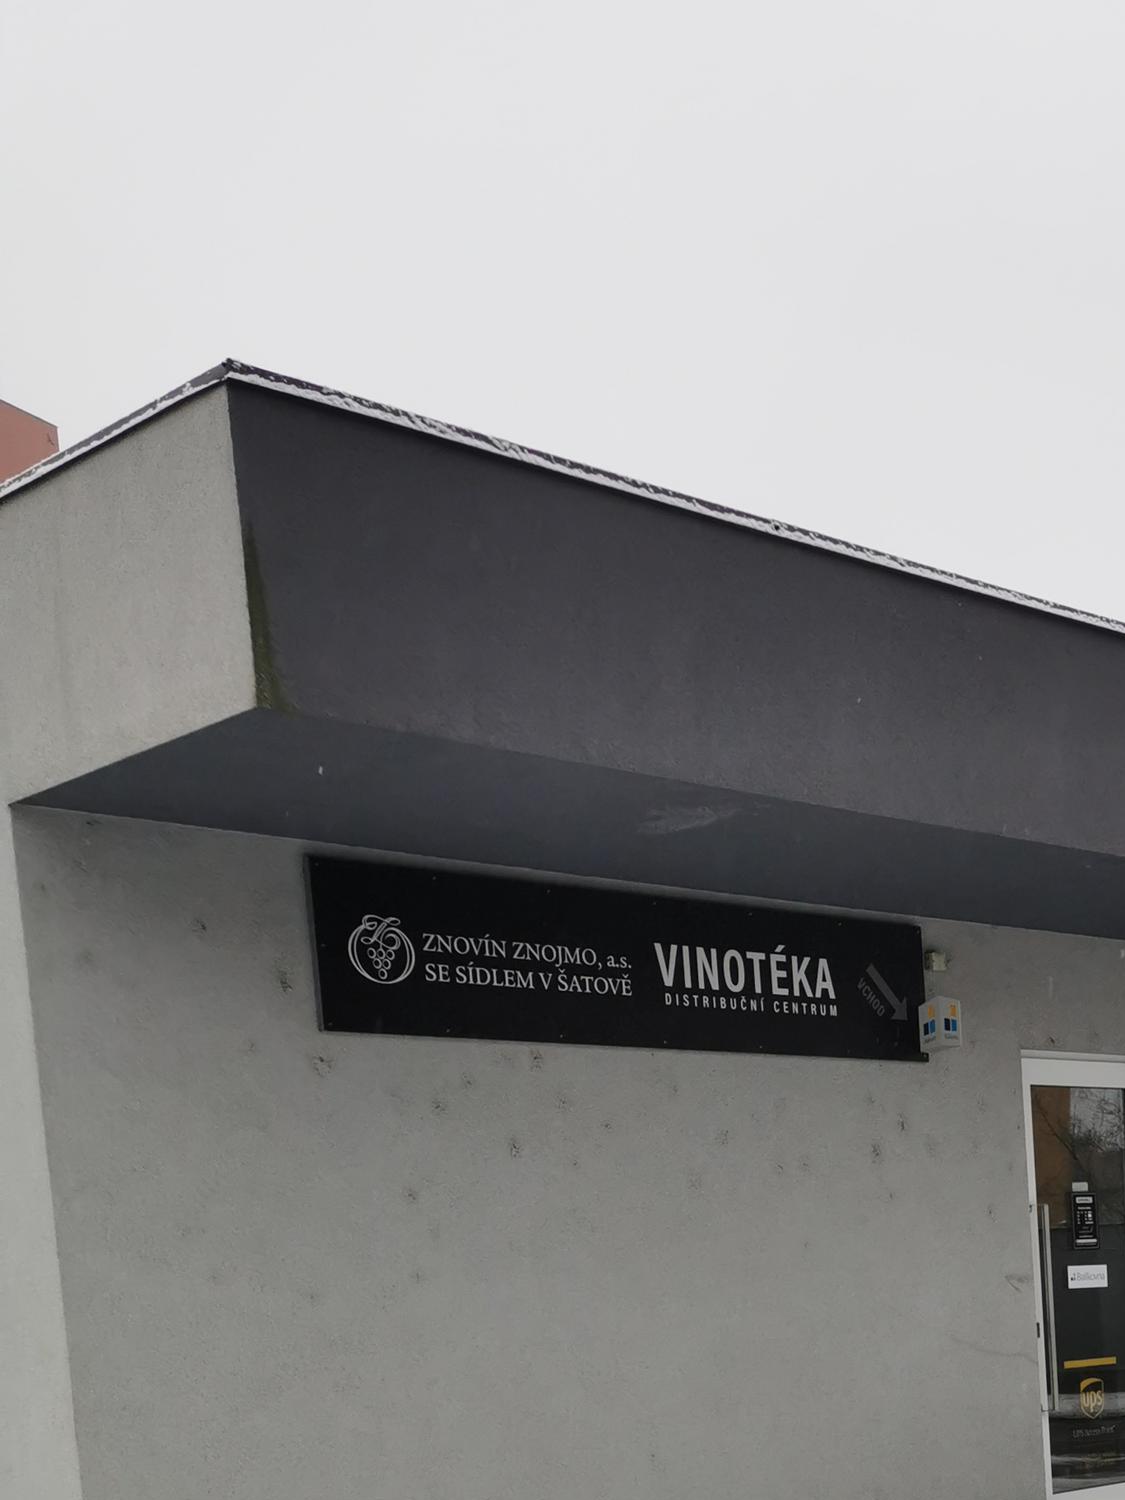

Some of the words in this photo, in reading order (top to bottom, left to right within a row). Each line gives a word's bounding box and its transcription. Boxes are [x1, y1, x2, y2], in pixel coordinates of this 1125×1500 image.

[422, 933, 507, 958] ZNOVÍN
[512, 941, 603, 970] ZNOJMO,
[606, 954, 632, 969] a.s.
[424, 963, 450, 983] SE
[455, 961, 535, 989] SÍDLEM
[538, 972, 553, 990] V
[557, 968, 633, 996] ŠATOVĚ
[653, 942, 836, 1000] VINOTÉKA
[664, 992, 765, 1012] DISTRIBUČNÍ
[773, 1001, 838, 1017] CENTRUM
[1083, 1390, 1103, 1413] ups
